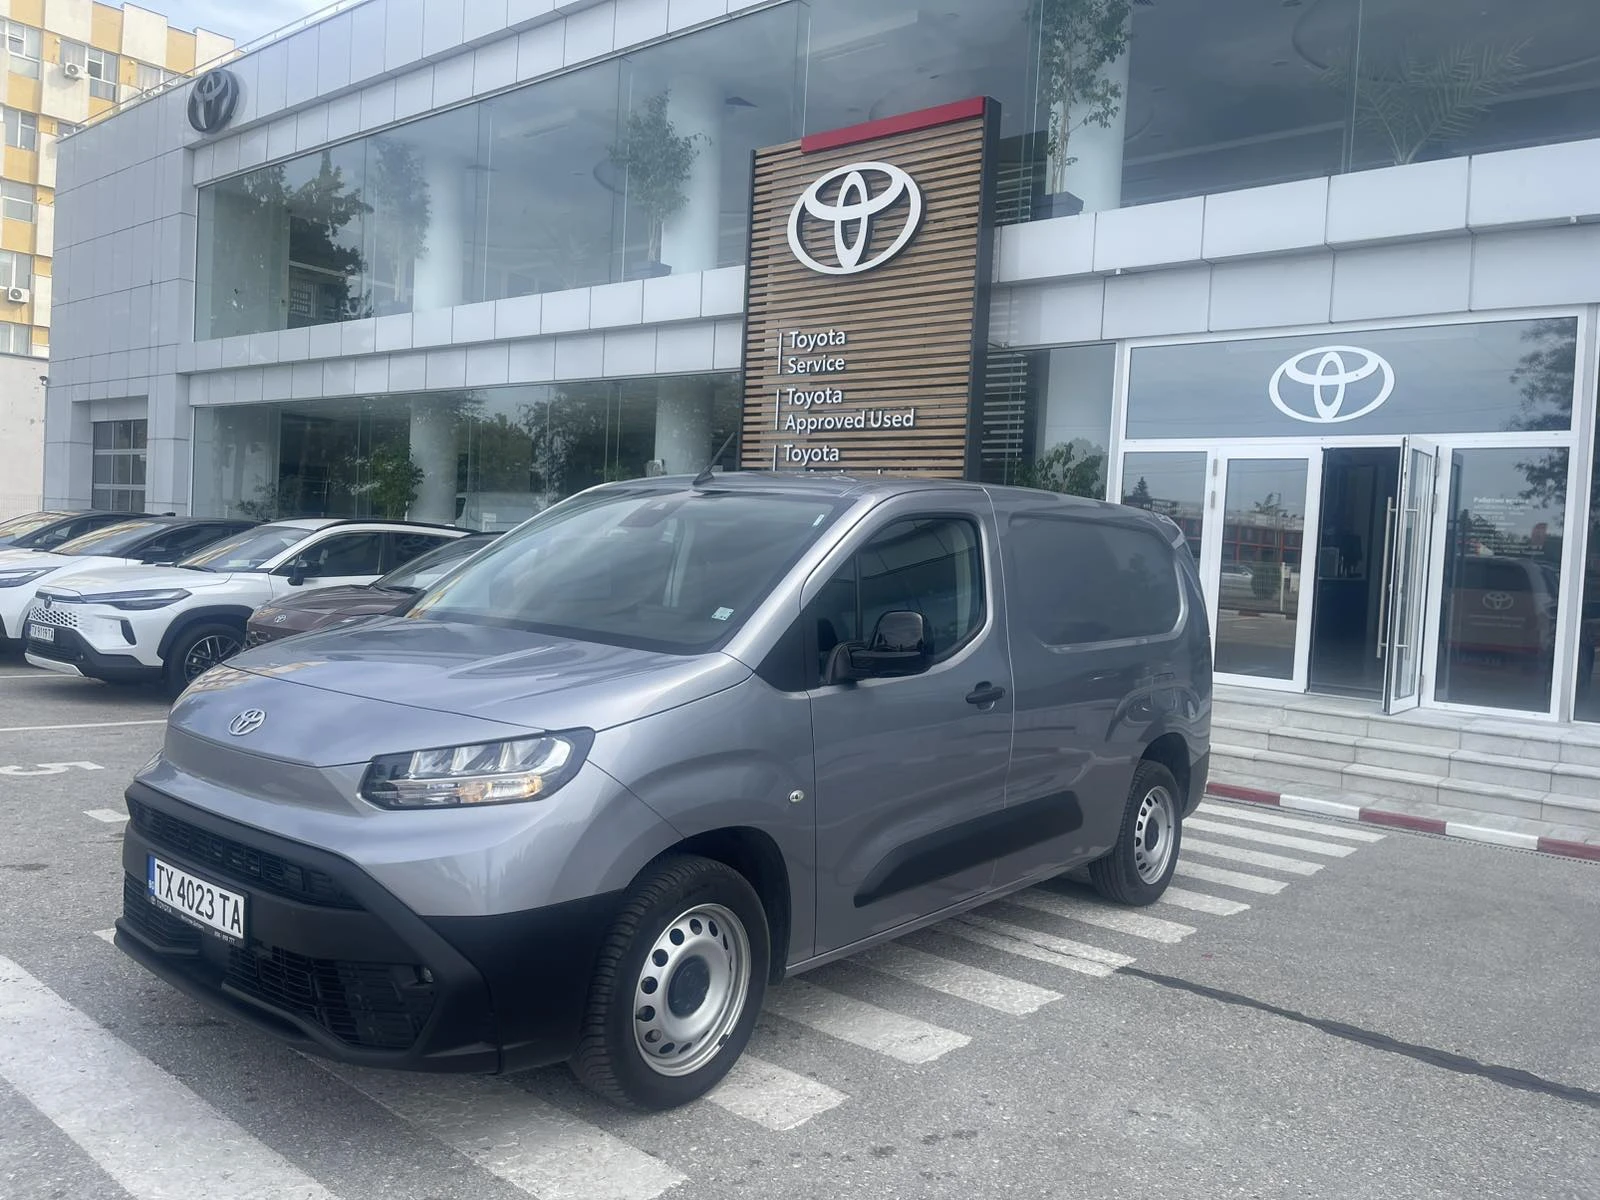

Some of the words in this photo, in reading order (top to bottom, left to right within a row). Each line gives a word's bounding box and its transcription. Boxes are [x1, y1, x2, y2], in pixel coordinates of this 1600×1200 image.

[789, 328, 846, 352] Toyota
[787, 354, 846, 375] Service
[786, 387, 843, 410] Toyota
[784, 410, 866, 434] Approved
[870, 408, 915, 428] Used
[784, 444, 840, 465] Toyota
[156, 863, 174, 901] TX
[177, 876, 215, 920] 4023
[219, 893, 242, 934] TA
